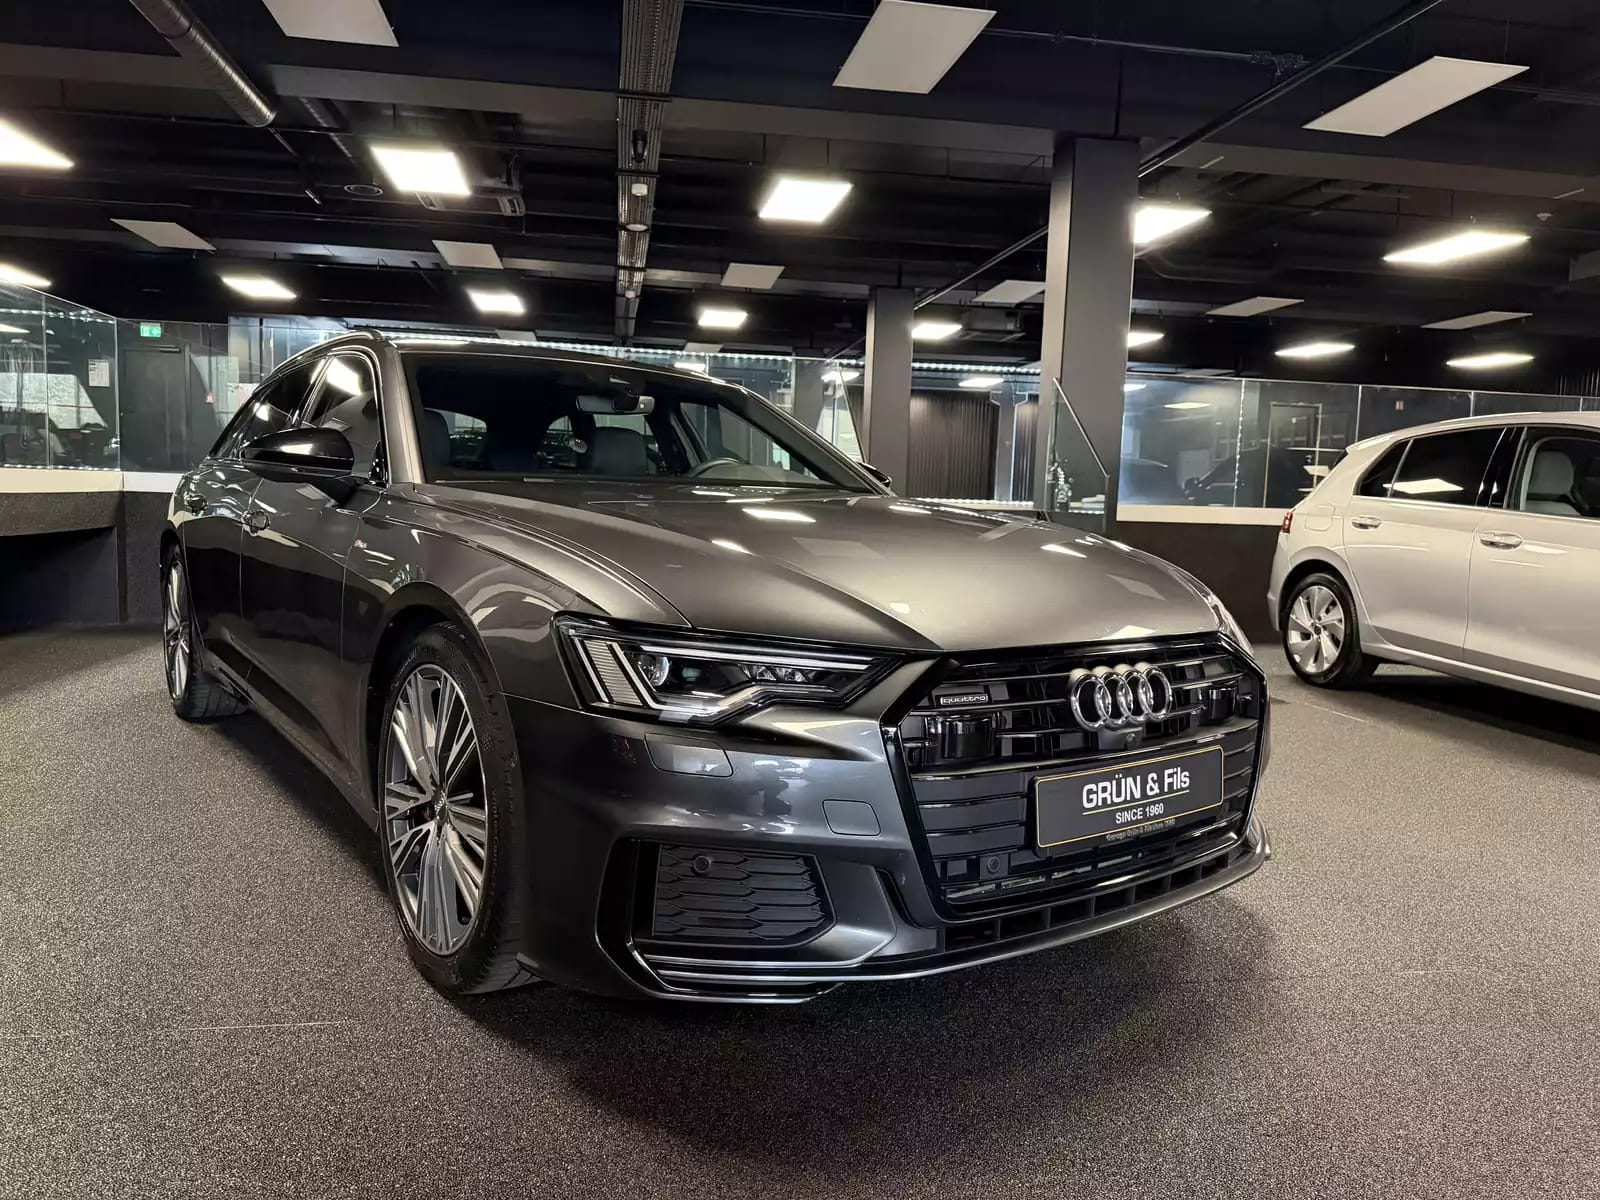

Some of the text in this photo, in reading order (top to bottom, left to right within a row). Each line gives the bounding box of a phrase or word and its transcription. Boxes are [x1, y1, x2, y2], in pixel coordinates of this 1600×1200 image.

[943, 695, 986, 704] quattro
[1082, 766, 1190, 809] GRÜN & Fils
[1115, 802, 1164, 824] SINCE 1960
